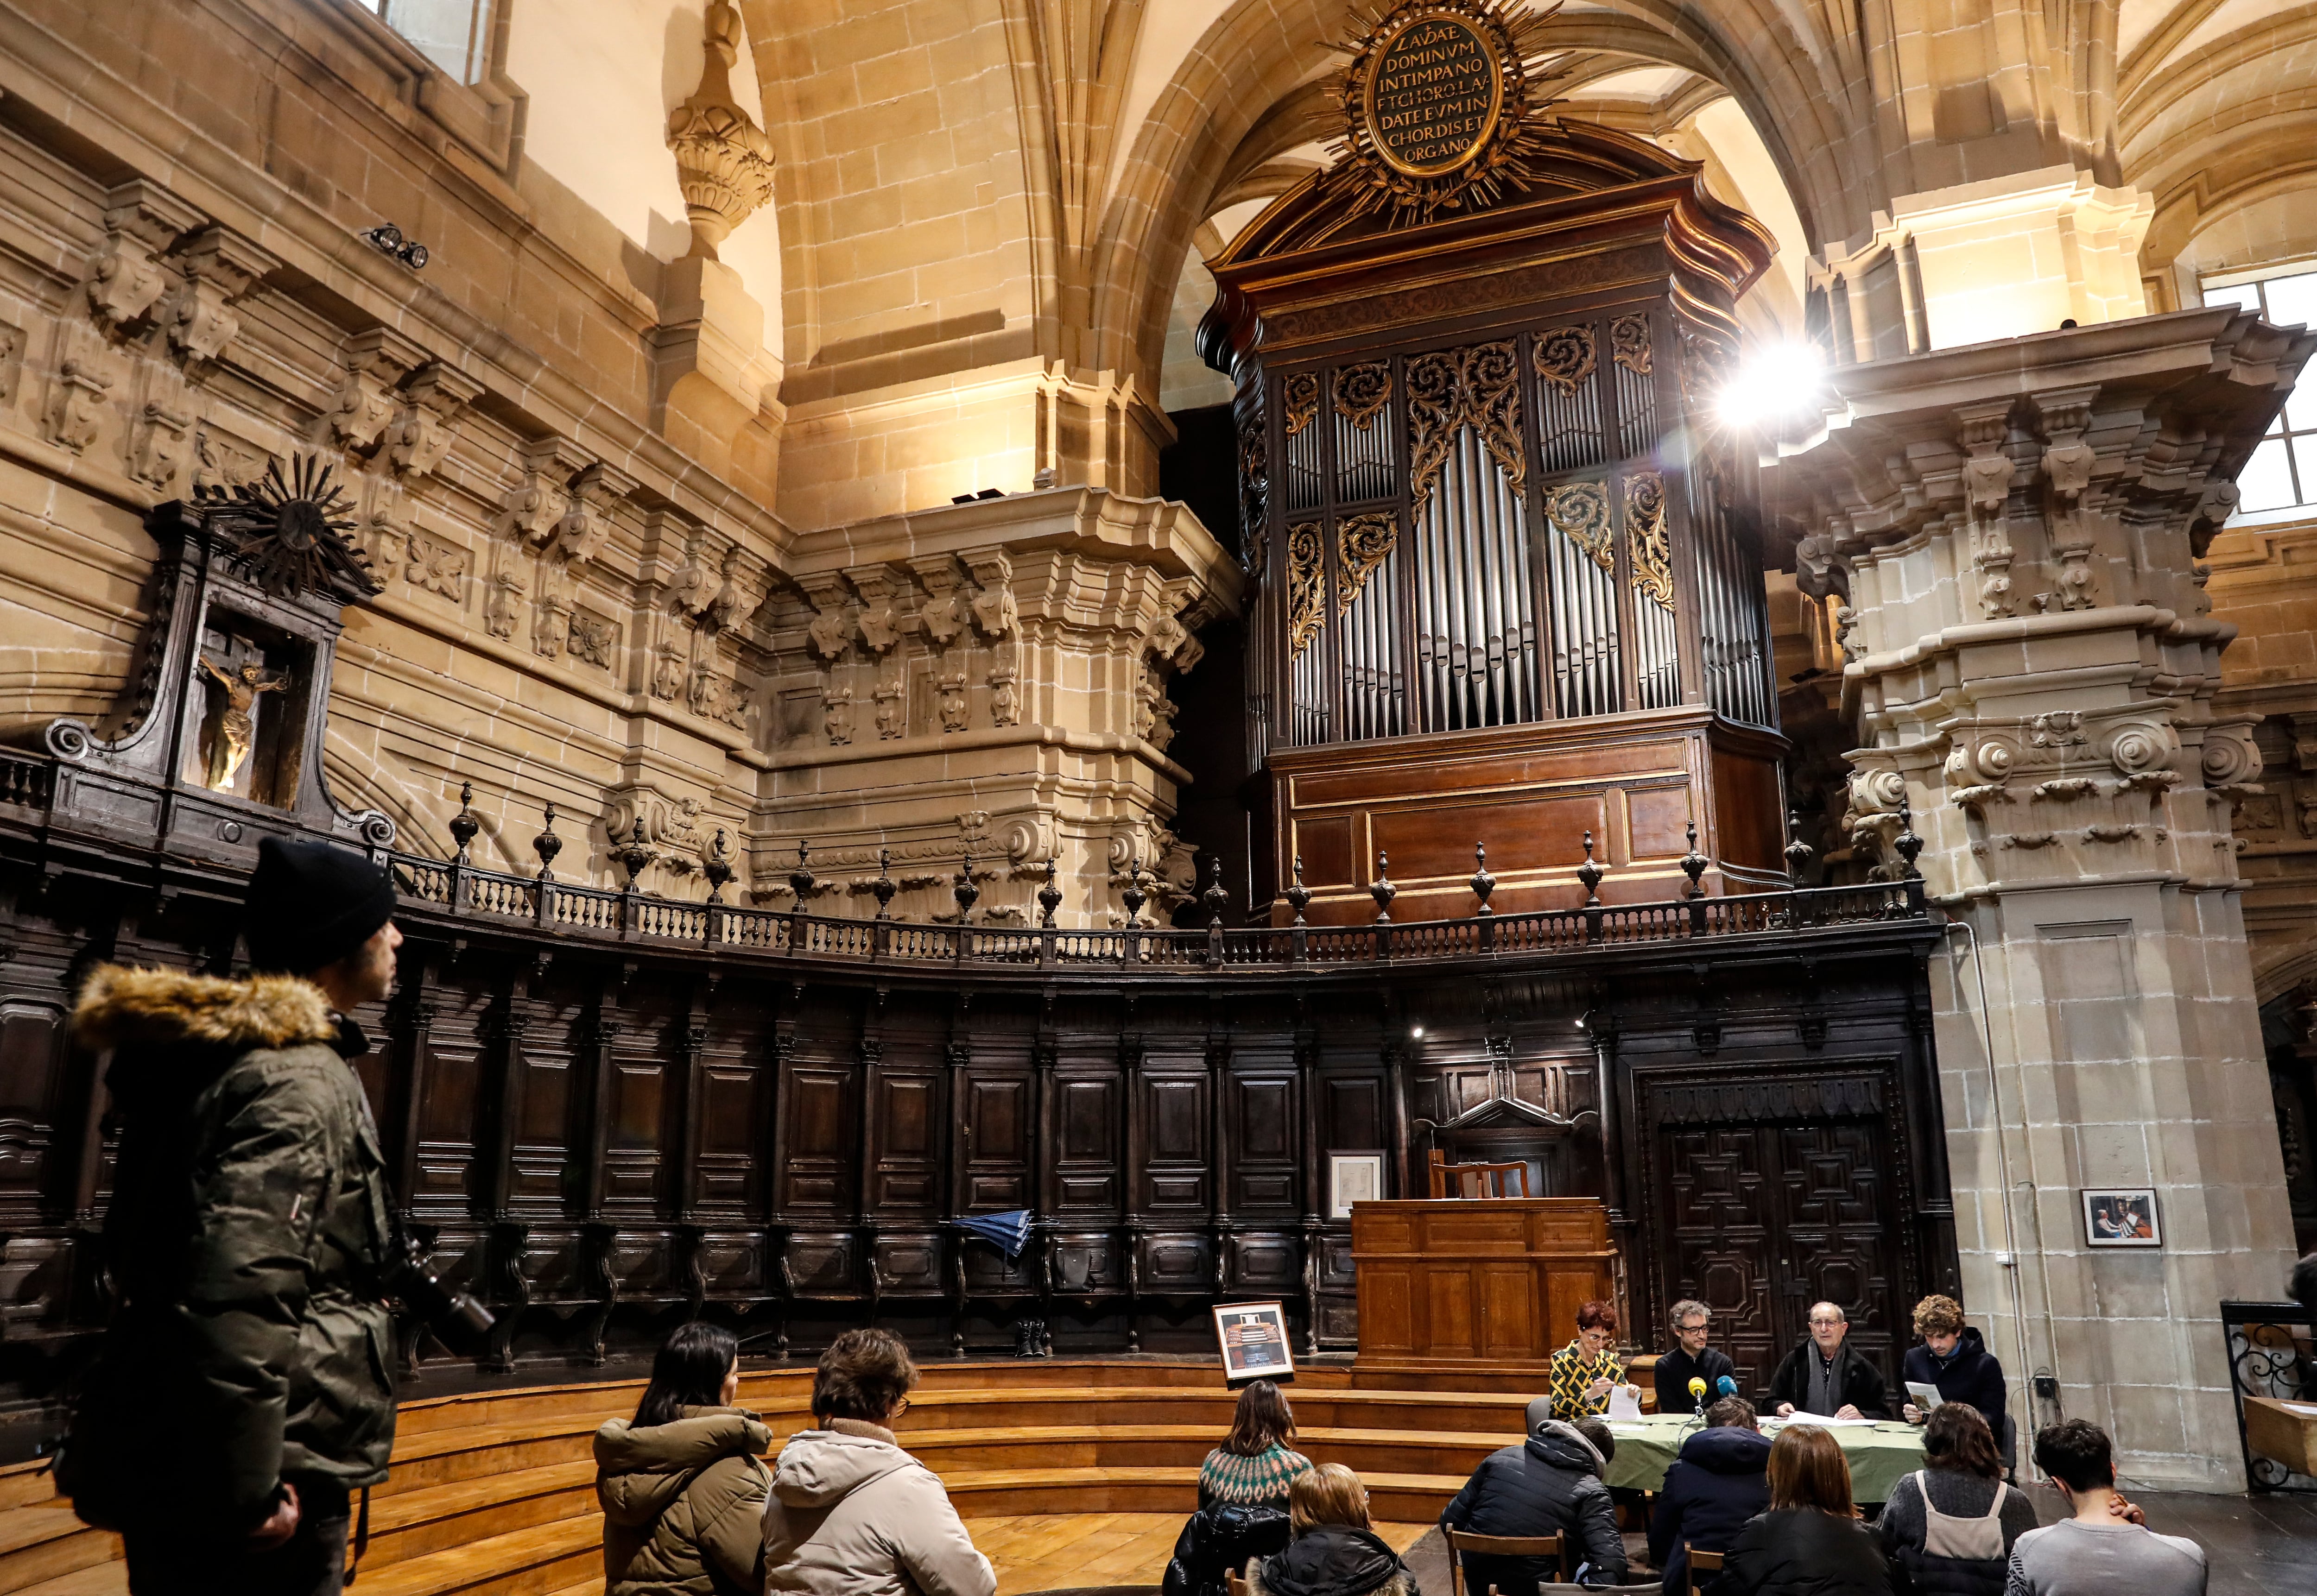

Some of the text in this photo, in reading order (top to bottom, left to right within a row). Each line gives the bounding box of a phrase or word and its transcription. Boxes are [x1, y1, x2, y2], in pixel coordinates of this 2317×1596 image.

[1386, 40, 1475, 73] DOMINVM
[1382, 110, 1421, 130] DATE
[1425, 101, 1463, 121] EVM
[1388, 115, 1486, 147] CHORDIS ET
